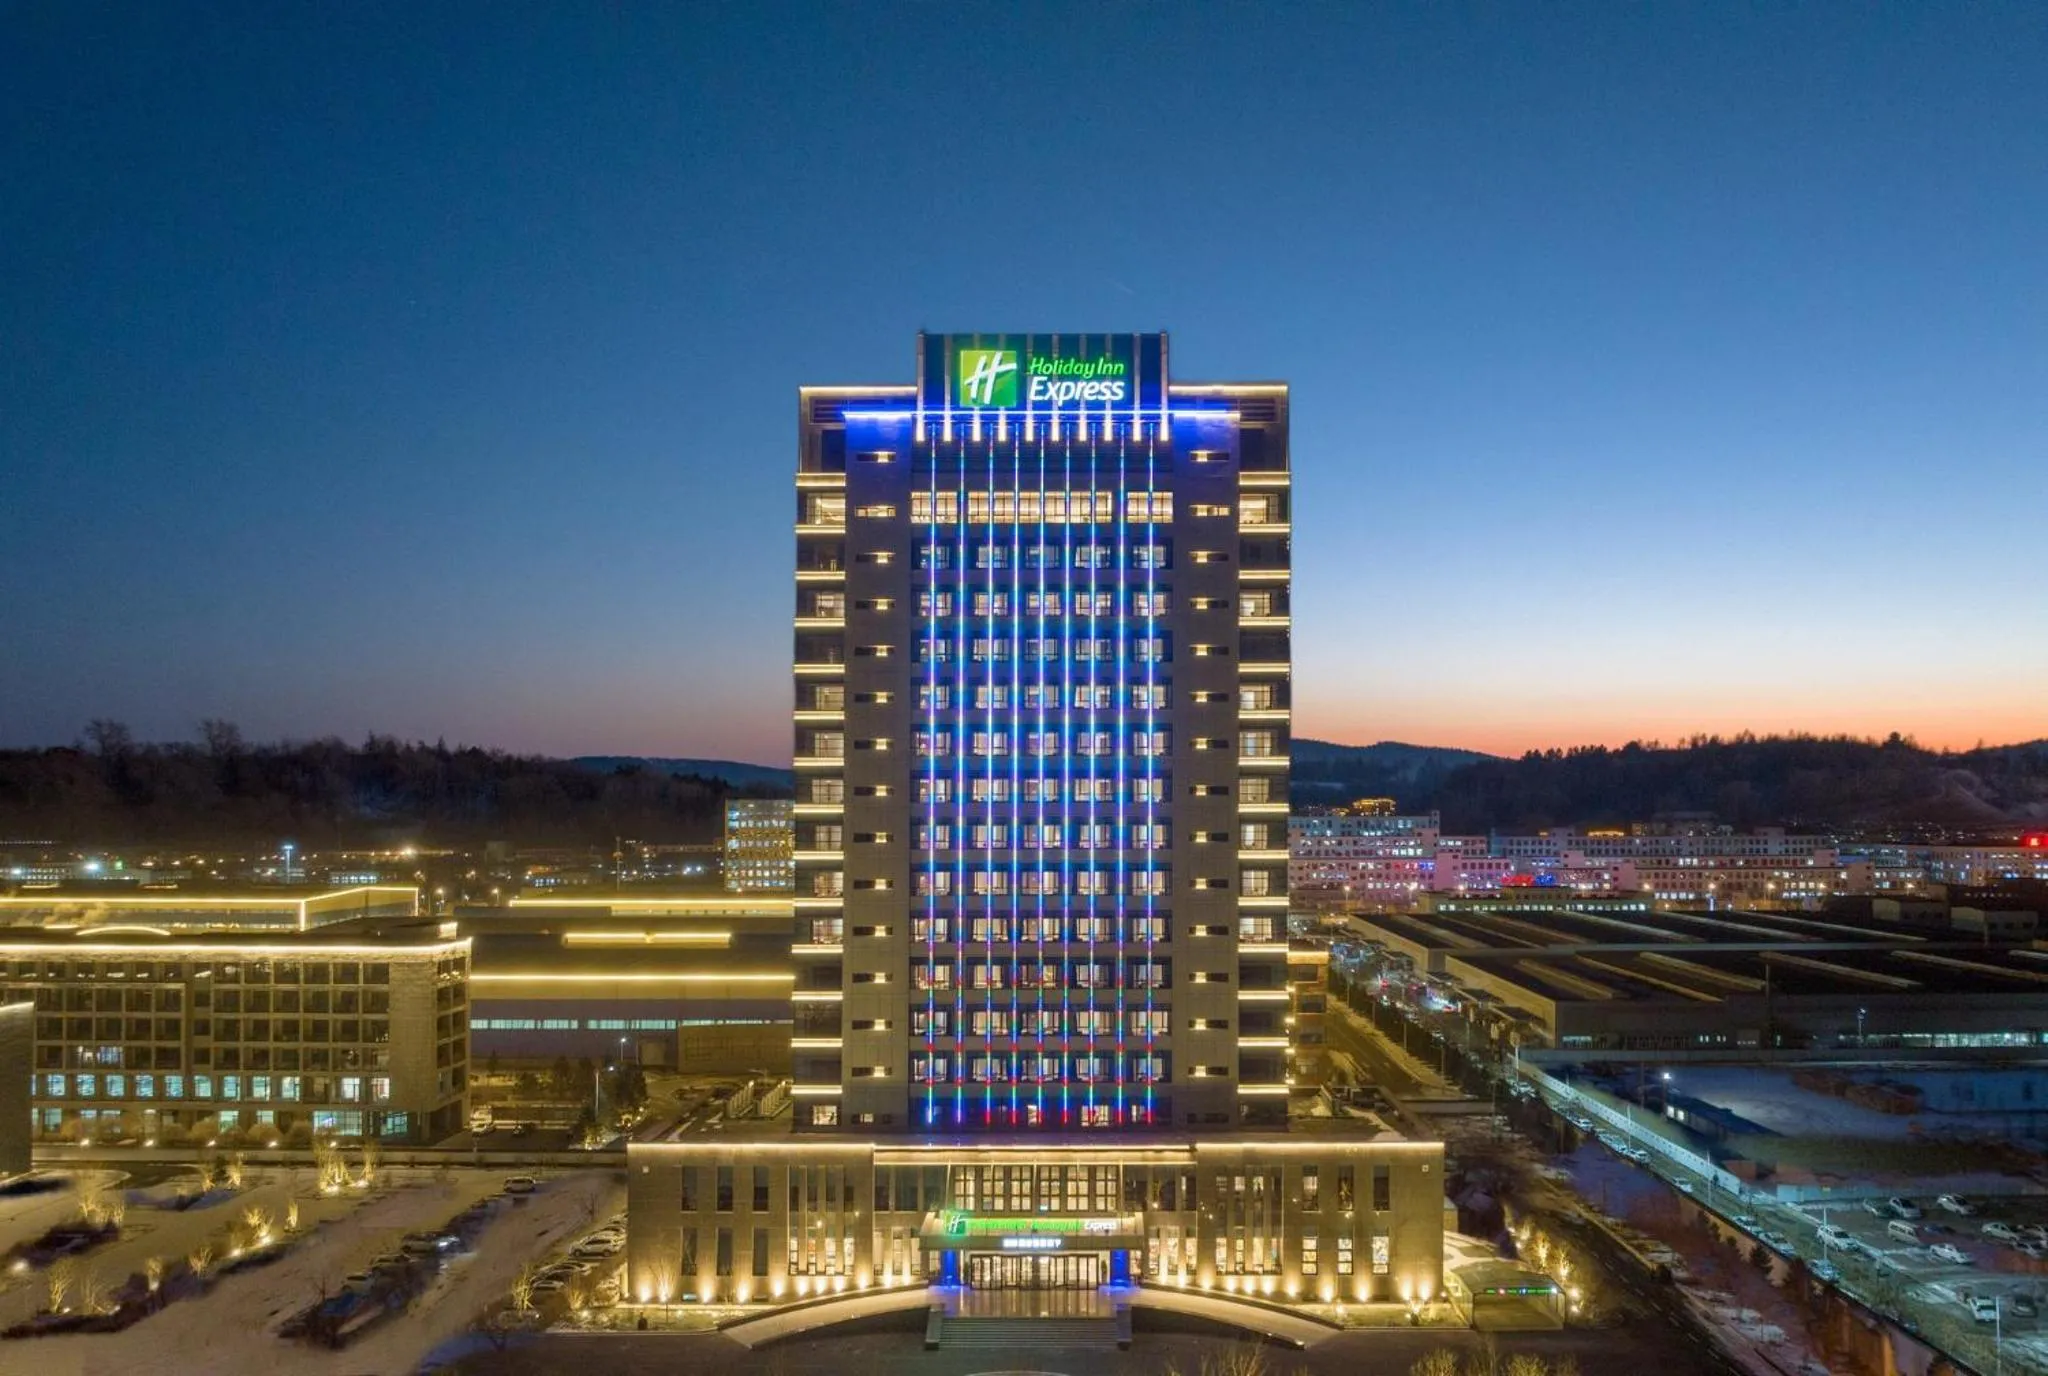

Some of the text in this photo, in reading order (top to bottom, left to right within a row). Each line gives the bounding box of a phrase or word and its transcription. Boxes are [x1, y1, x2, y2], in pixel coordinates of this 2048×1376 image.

[964, 351, 1017, 405] H
[1029, 356, 1124, 379] Holiday Inn
[1029, 376, 1125, 407] Express
